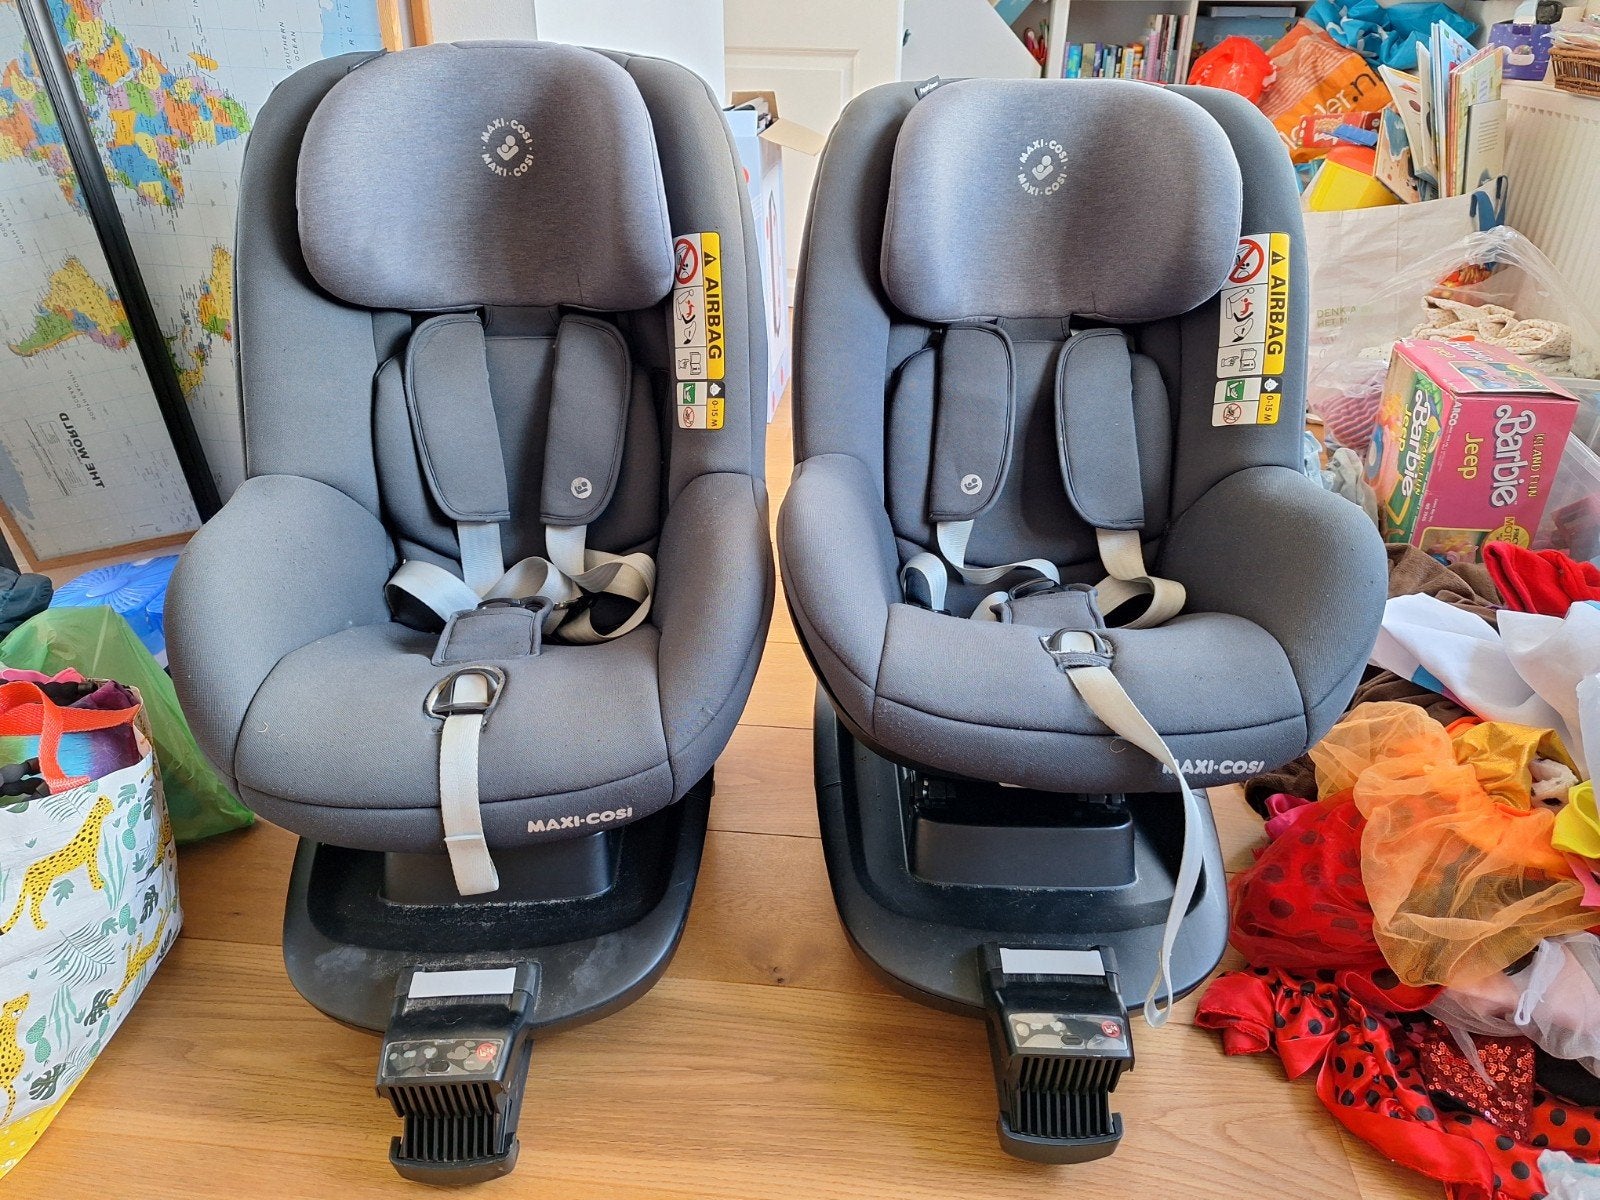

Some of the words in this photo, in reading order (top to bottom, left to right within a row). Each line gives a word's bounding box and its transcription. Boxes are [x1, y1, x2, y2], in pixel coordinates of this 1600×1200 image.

[280, 22, 292, 69] SOUTHERN
[291, 31, 300, 61] OCEAN
[705, 277, 722, 360] AIRBAG
[1267, 275, 1286, 355] AIRBAG
[1316, 306, 1346, 318] DENK
[1400, 404, 1412, 452] Jeep
[1448, 402, 1463, 426] ARCO
[1402, 390, 1431, 496] Barbie
[1457, 432, 1484, 480] Jeep
[1491, 404, 1537, 507] Barbie
[1528, 475, 1540, 497] FUN
